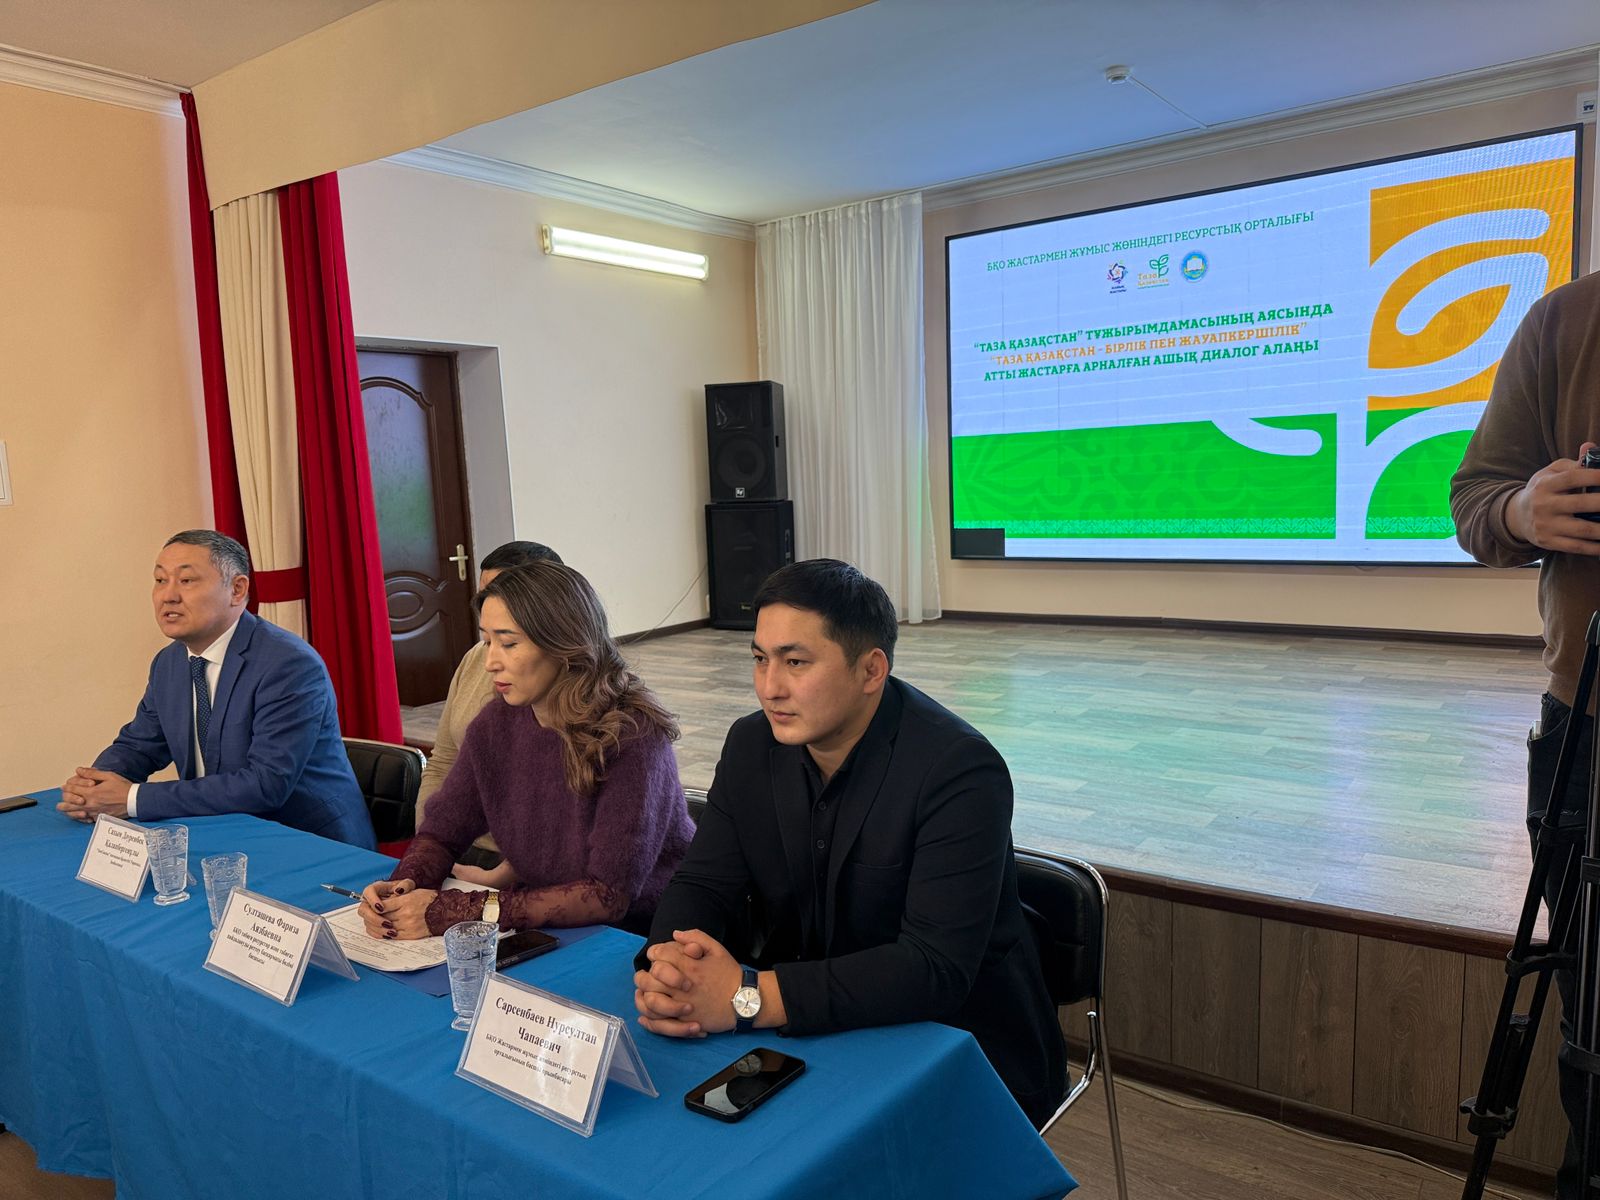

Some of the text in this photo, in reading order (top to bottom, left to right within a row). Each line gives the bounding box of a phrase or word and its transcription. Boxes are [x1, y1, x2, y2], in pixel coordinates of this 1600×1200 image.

[987, 211, 1314, 272] БҚО ЖАСТАРМЕН ЖҰМЫС ЖӨНІНДЕГІ РЕСУРСТЫҚ ОРТАЛЫҒЫ
[1086, 312, 1254, 340] ТҰЖЫРЫМДАМАСЫНЫҢ
[1257, 303, 1333, 322] АЯСЫНДА
[984, 340, 1319, 382] АТТЫ ЖАСТАРҒА АРНАЛҒАН АШЫҚ ДИАЛОГ АЛАҢЫ
[1026, 346, 1095, 363] ҚАЗАҚСТАН
[1105, 340, 1146, 354] БІРЛІК
[1150, 337, 1176, 349] ПЕН
[251, 922, 282, 942] Аязбаевна
[276, 918, 300, 935] Фариза
[495, 997, 598, 1045] Сарсенбаев Нурсултан
[518, 1026, 562, 1054] Чапаевич
